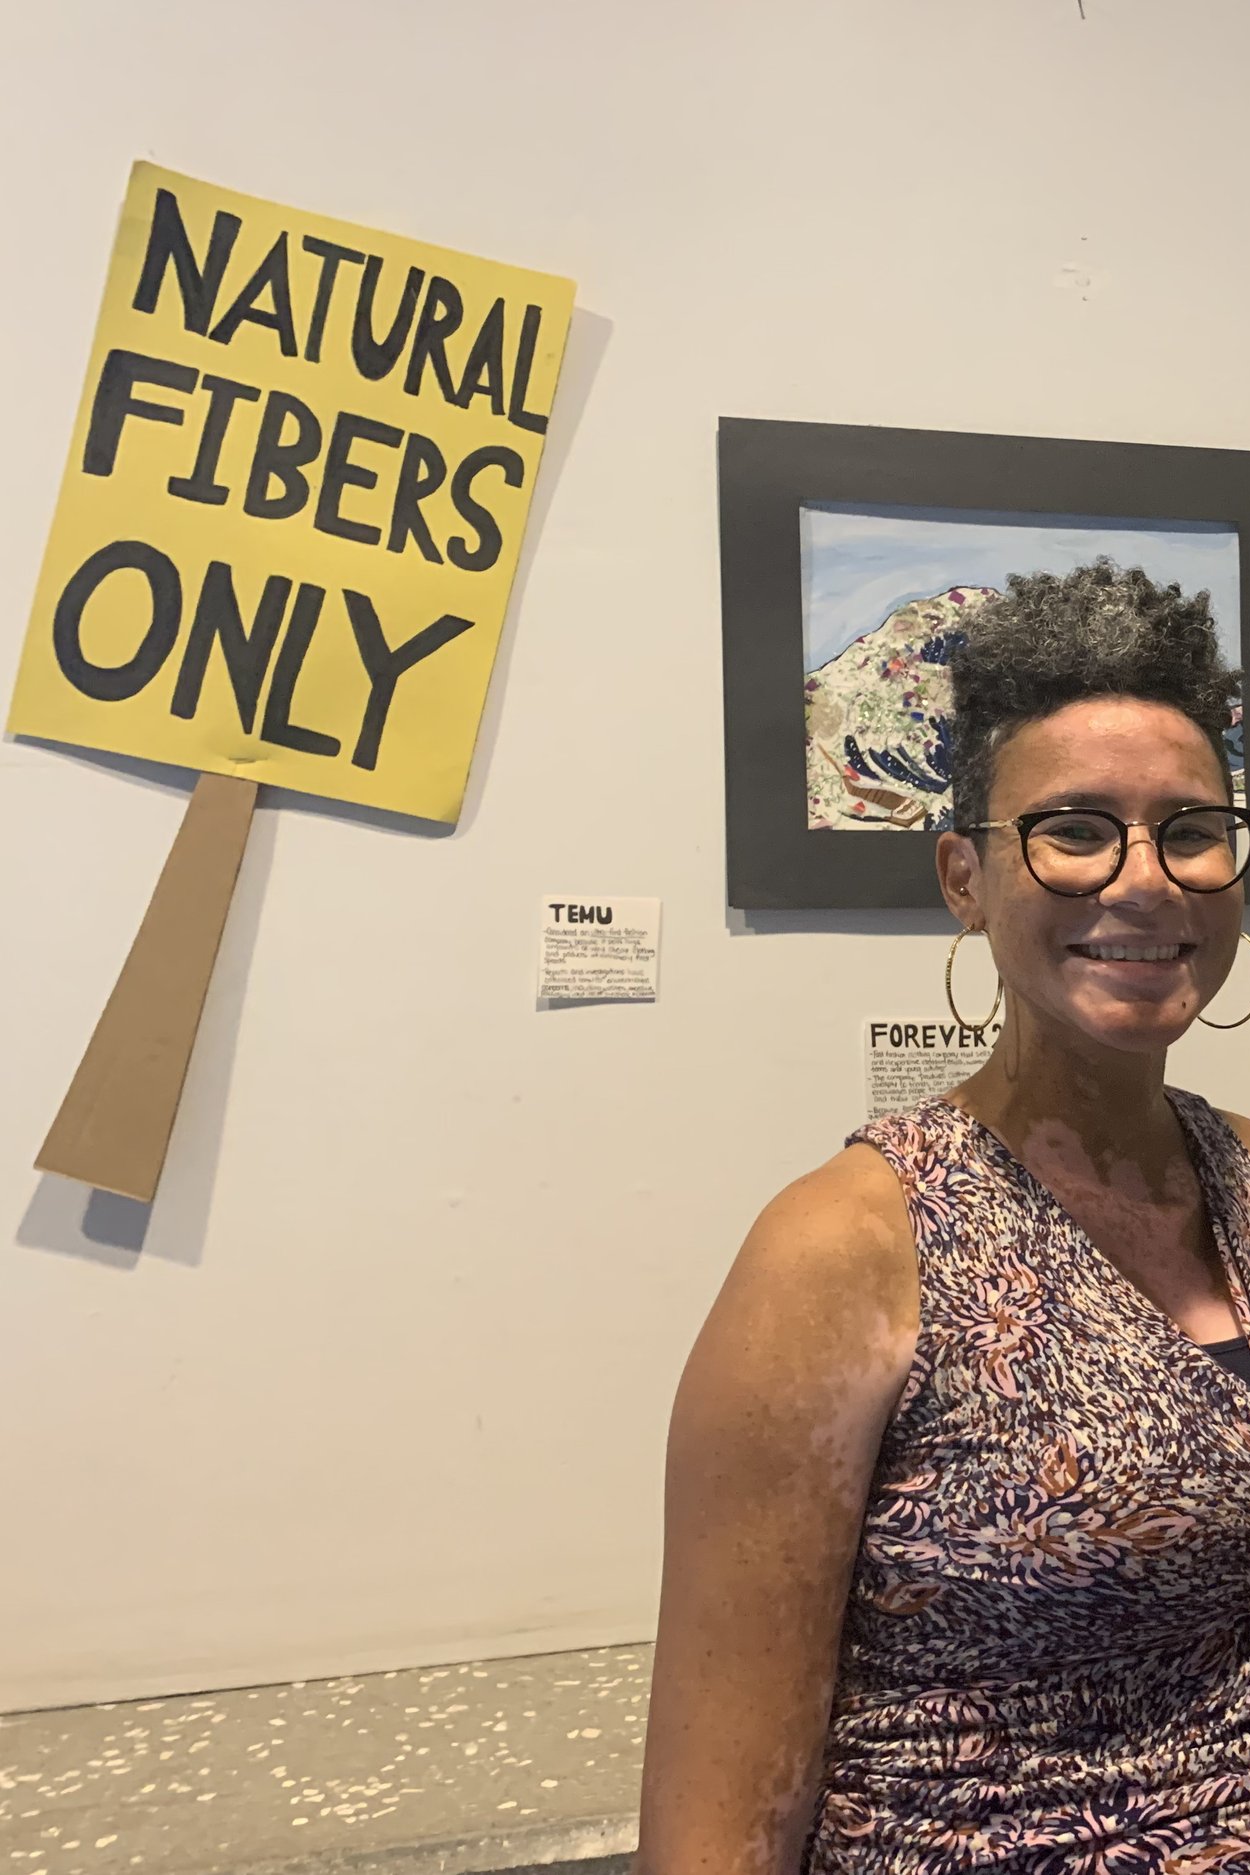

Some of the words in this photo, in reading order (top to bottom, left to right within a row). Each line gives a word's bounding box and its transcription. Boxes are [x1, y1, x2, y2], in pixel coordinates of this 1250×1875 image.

[132, 188, 548, 435] NATURAL
[82, 349, 524, 572] FIBERS
[53, 541, 476, 770] ONLY
[548, 904, 612, 924] TEMU
[870, 1023, 987, 1048] FOREVER
